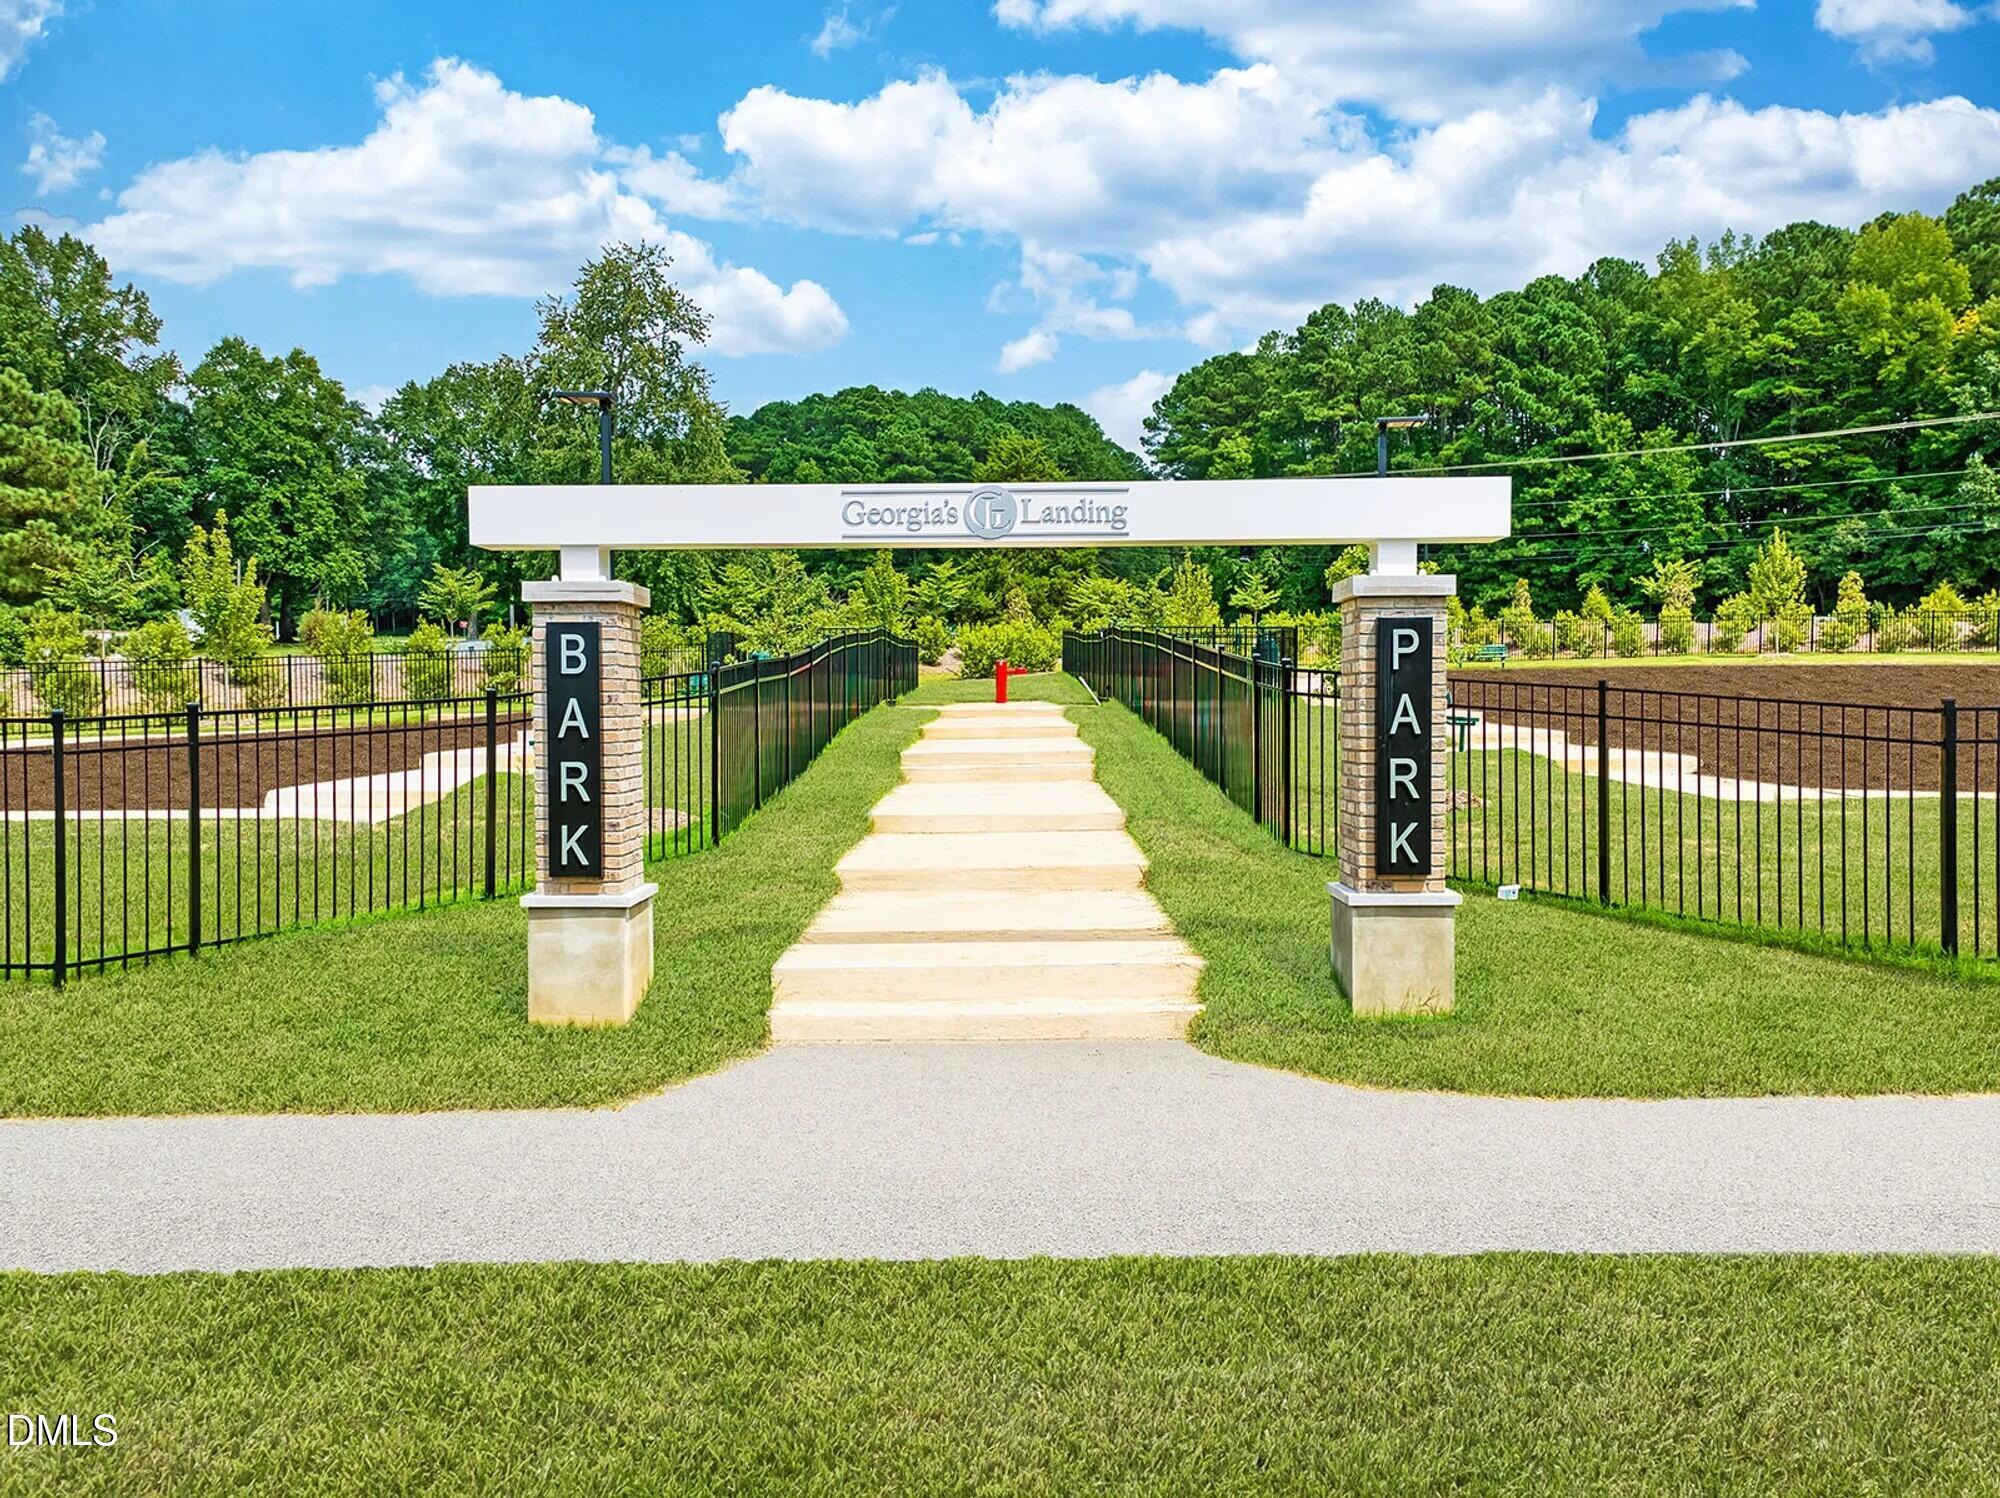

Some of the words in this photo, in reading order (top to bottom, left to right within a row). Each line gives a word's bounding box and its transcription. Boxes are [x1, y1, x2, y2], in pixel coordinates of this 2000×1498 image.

[842, 499, 958, 532] Georgia's
[1020, 498, 1128, 530] Landing
[558, 633, 591, 866] BARK
[1389, 628, 1421, 863] PARK
